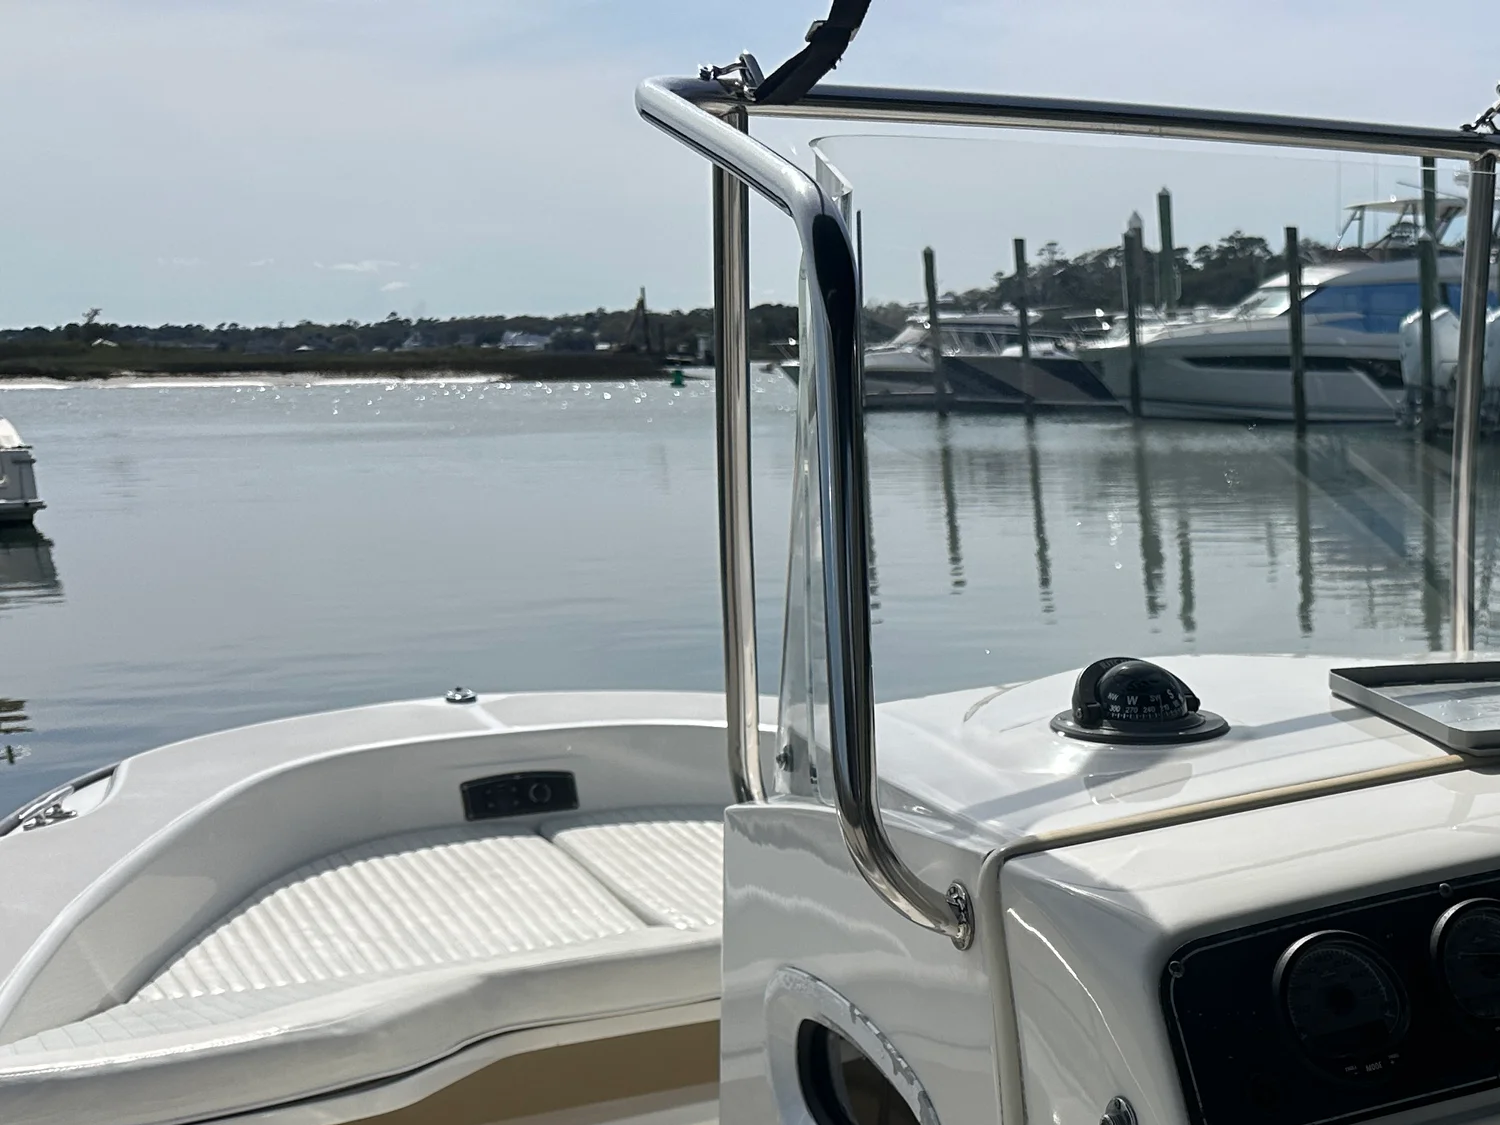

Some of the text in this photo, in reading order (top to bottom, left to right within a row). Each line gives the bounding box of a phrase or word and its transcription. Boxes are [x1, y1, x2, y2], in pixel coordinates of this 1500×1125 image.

[1126, 696, 1139, 706] W
[1167, 689, 1174, 700] S
[1366, 1060, 1383, 1072] MODE
